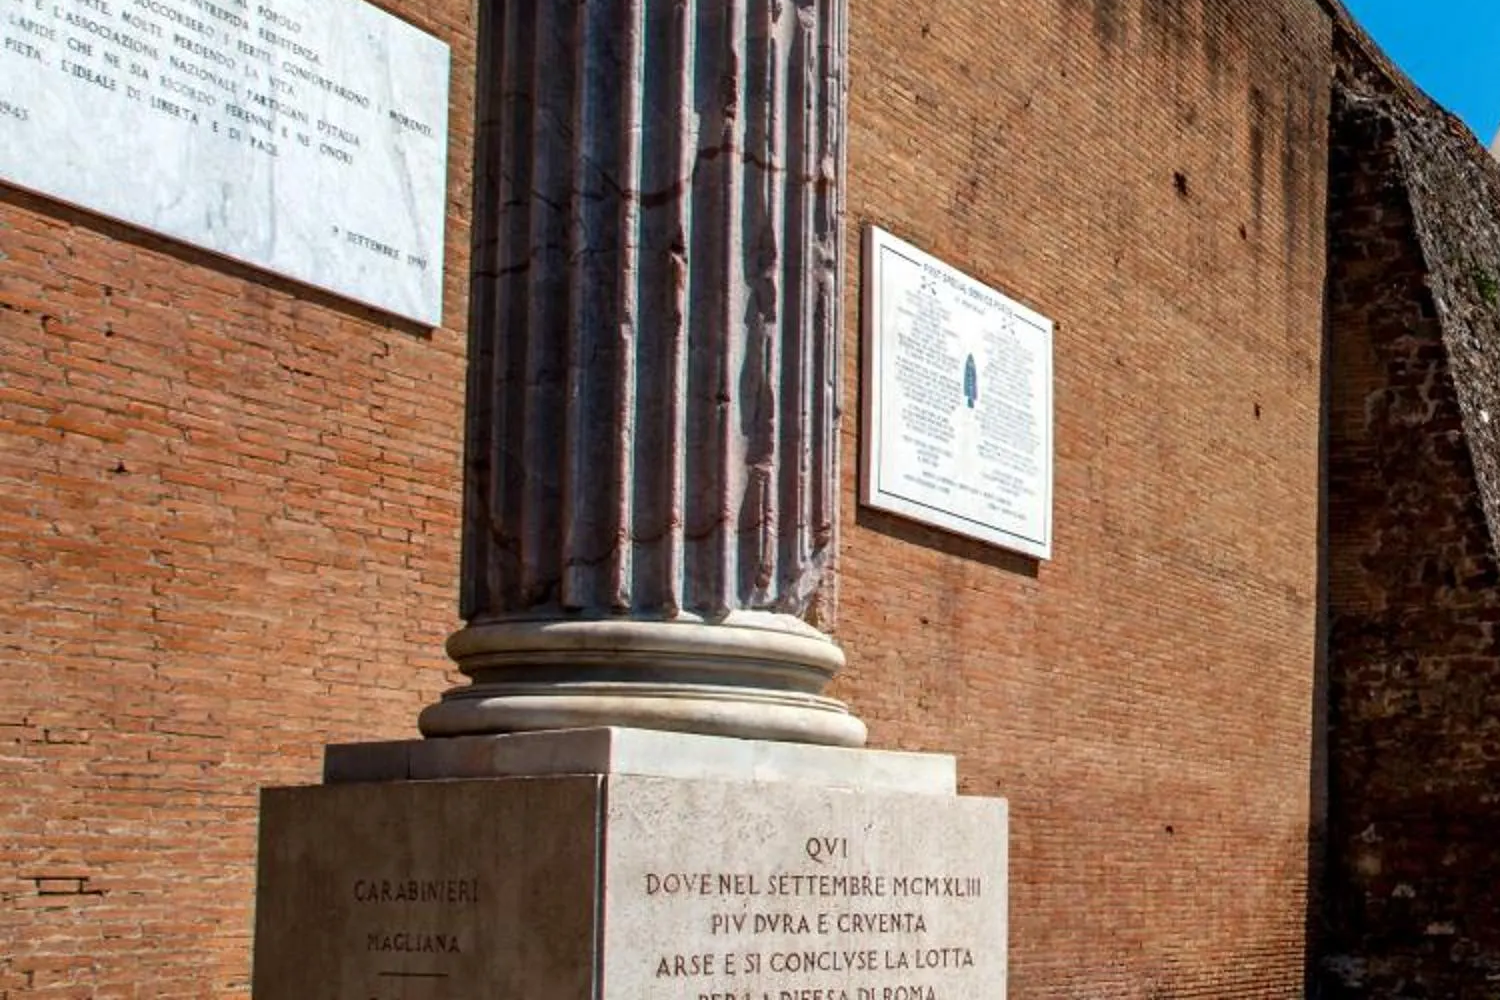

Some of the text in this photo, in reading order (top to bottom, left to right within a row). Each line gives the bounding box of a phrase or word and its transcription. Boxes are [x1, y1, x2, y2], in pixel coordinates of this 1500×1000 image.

[806, 837, 847, 863] QVI
[354, 878, 478, 903] CARABINIERI
[645, 873, 981, 897] DOVE NEL SETTEMBRE MCMXLIII
[754, 914, 811, 935] DVRA
[818, 914, 829, 934] E
[837, 913, 927, 934] CRVENTA
[367, 933, 461, 953] MAGLIANA
[656, 948, 975, 978] ARSE E SI CONCLVSE LA LOTTA
